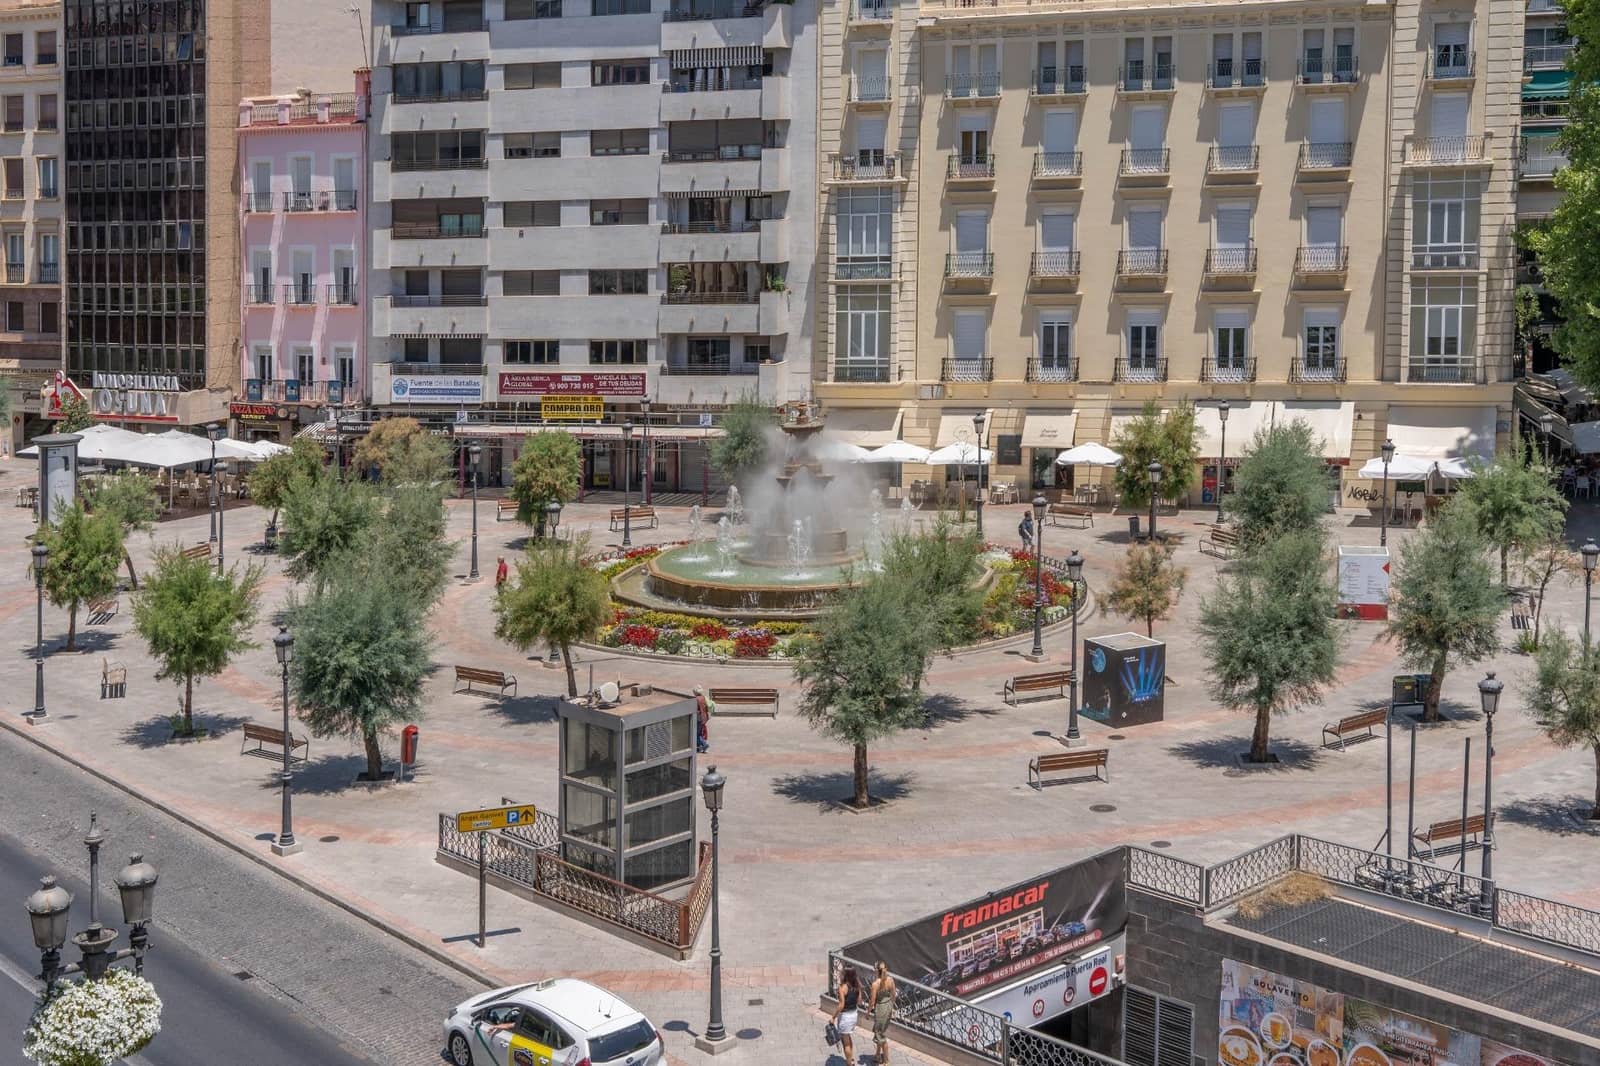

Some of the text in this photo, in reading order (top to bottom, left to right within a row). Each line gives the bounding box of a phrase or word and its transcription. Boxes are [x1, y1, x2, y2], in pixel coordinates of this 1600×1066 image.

[93, 371, 179, 391] INMOBILIARIA
[557, 382, 569, 390] 900
[99, 388, 166, 416] OSUNA
[231, 404, 251, 414] PIZZA
[544, 404, 602, 412] COMPRO ORO
[941, 882, 1049, 936] framacar
[1024, 954, 1108, 997] Aparcamiento Puerta Real
